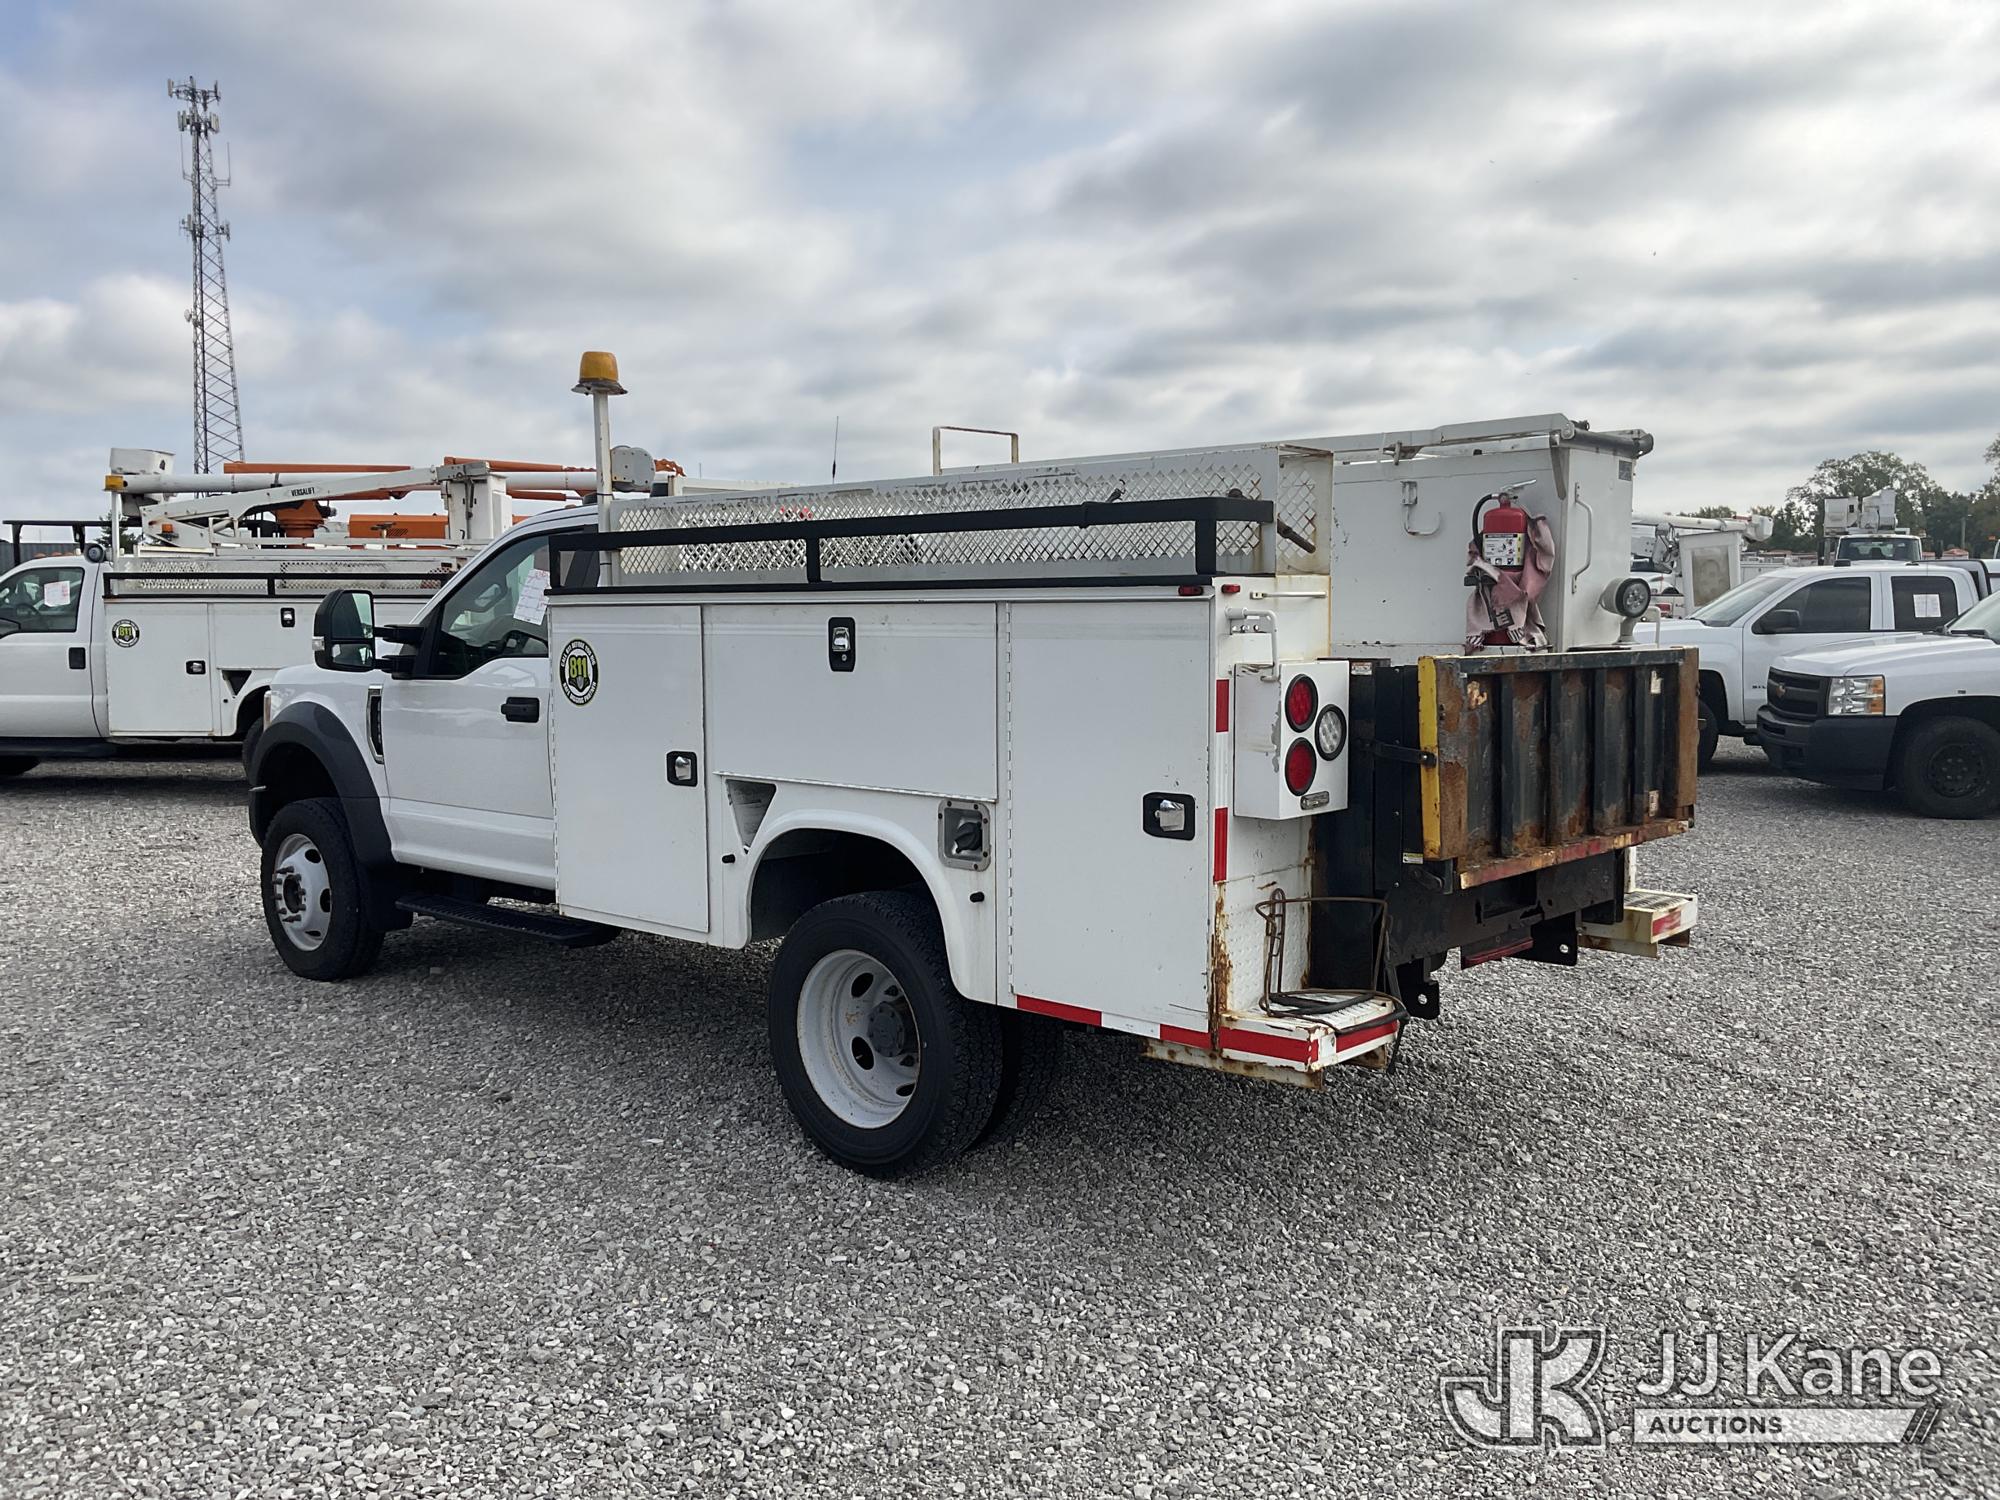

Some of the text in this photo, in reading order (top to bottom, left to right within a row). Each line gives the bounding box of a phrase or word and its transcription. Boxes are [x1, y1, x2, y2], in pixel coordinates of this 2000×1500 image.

[291, 487, 315, 497] VERSALIFT
[120, 627, 131, 636] 811
[570, 656, 587, 678] 811
